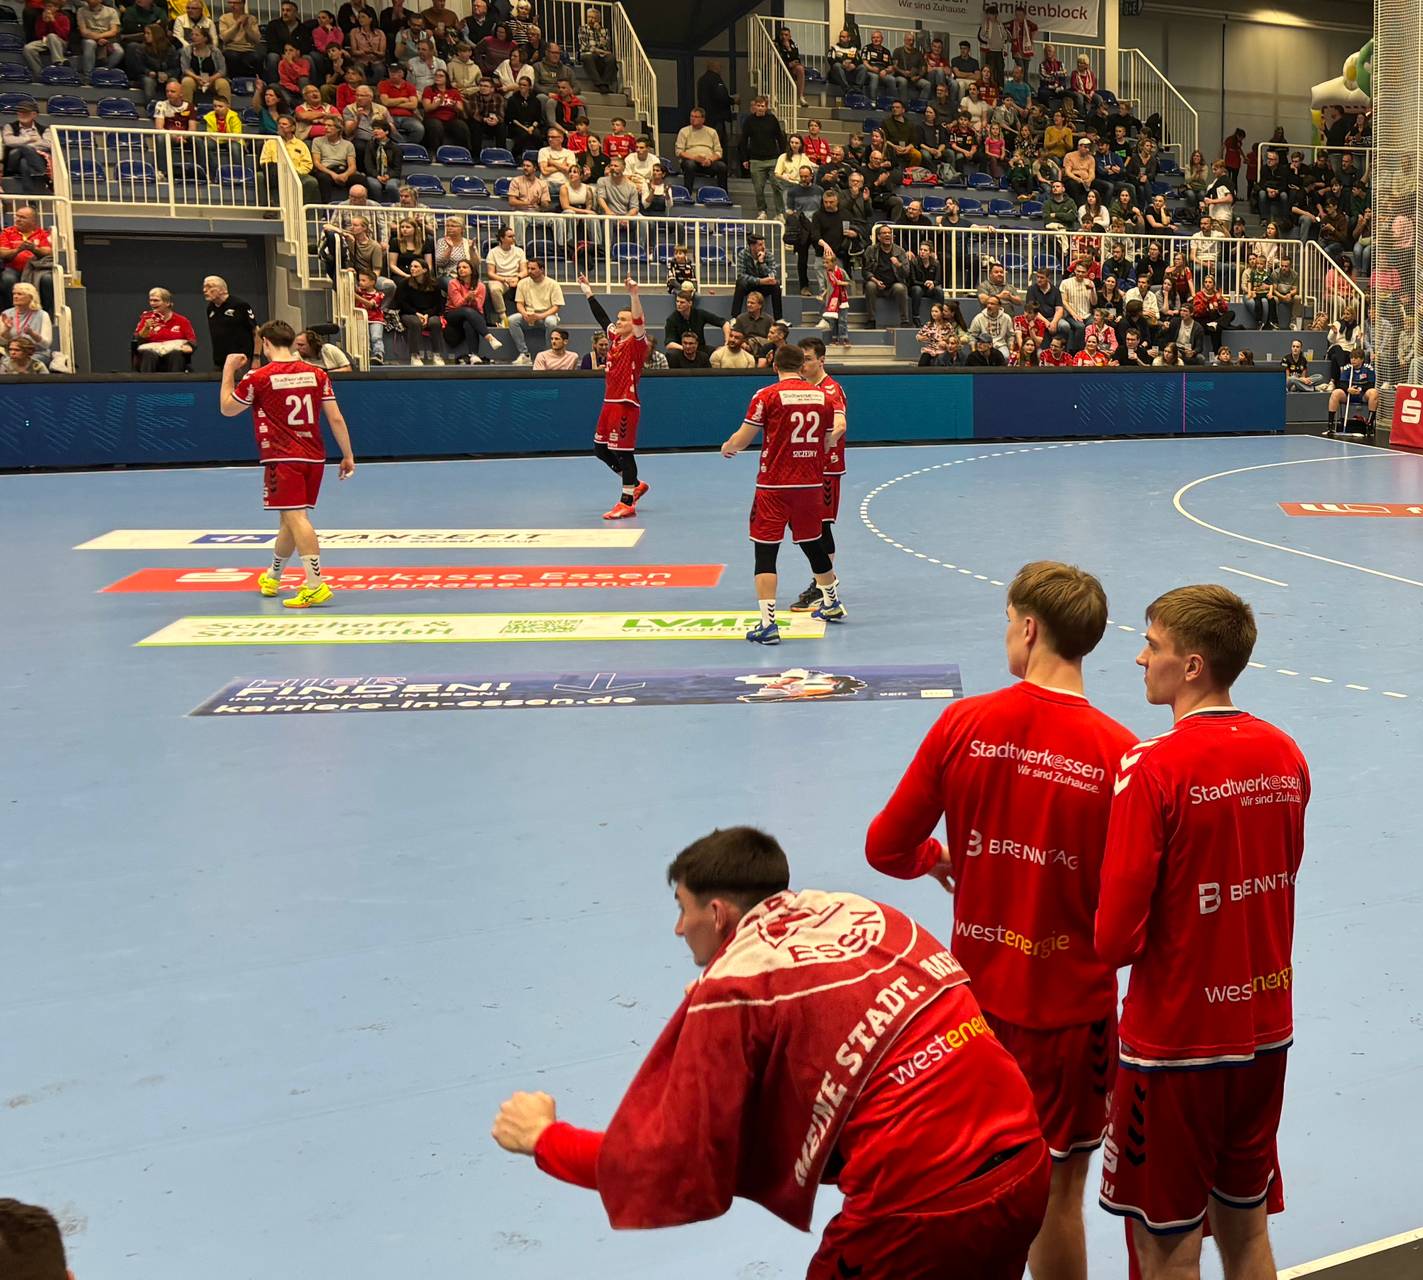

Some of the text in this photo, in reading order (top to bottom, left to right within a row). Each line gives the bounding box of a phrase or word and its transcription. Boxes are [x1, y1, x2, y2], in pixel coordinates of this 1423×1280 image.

[285, 394, 315, 426] 21
[790, 410, 820, 444] 22
[540, 571, 672, 581] Essen
[622, 618, 738, 628] LVM
[336, 628, 454, 636] GmbH
[236, 682, 511, 697] FINDEN!
[214, 696, 637, 713] karriere-in-essen.de
[1016, 763, 1031, 775] Wir
[1031, 768, 1053, 781] sind
[1240, 796, 1252, 807] Wir
[1254, 793, 1274, 805] sind
[787, 909, 881, 963] ESSEN
[955, 919, 1070, 959] westenergie
[835, 975, 927, 1077] STADT.
